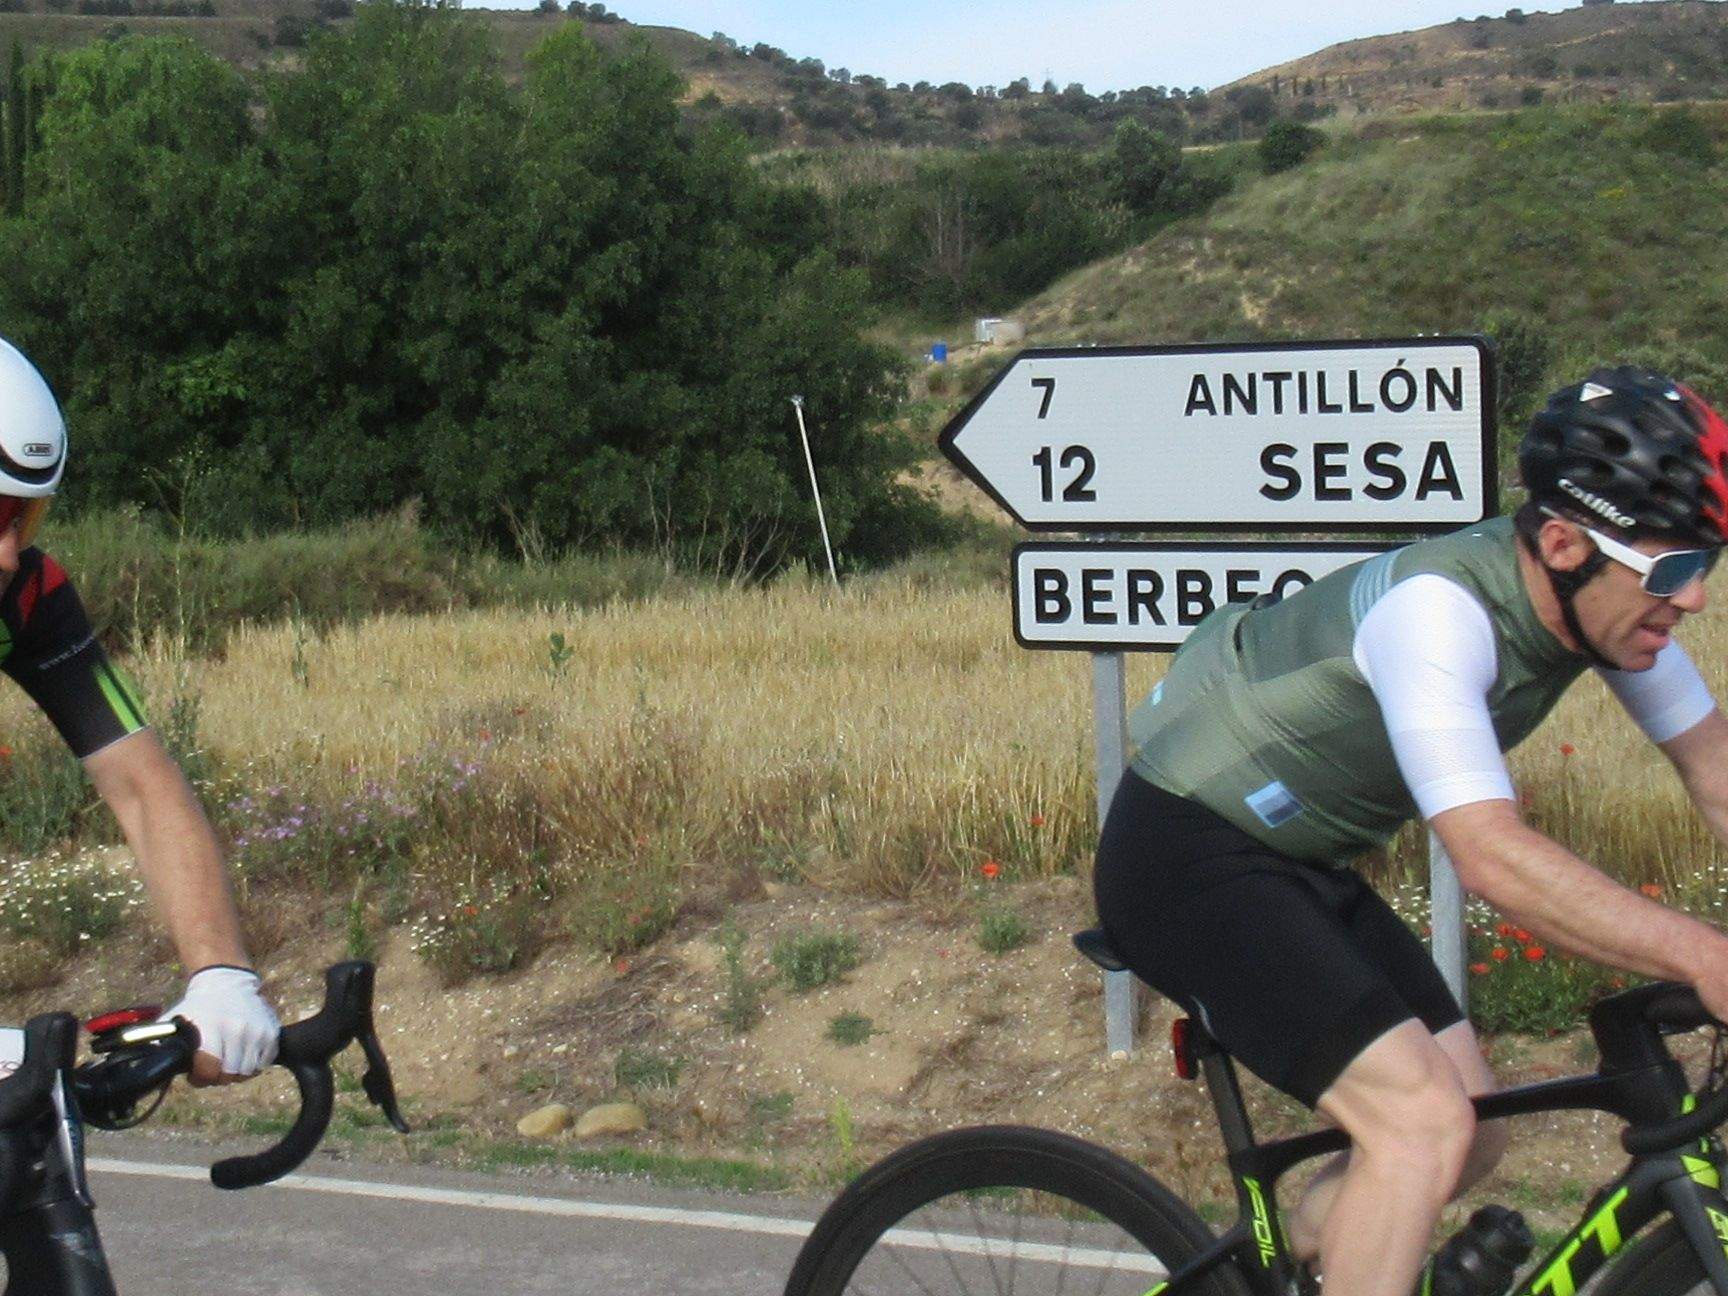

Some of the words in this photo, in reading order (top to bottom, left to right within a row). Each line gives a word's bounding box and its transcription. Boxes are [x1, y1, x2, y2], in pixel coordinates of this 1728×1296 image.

[1030, 377, 1056, 419] 7
[1183, 359, 1463, 417] ANTILLÓN
[1031, 444, 1097, 502] 12
[1258, 440, 1464, 501] SESA
